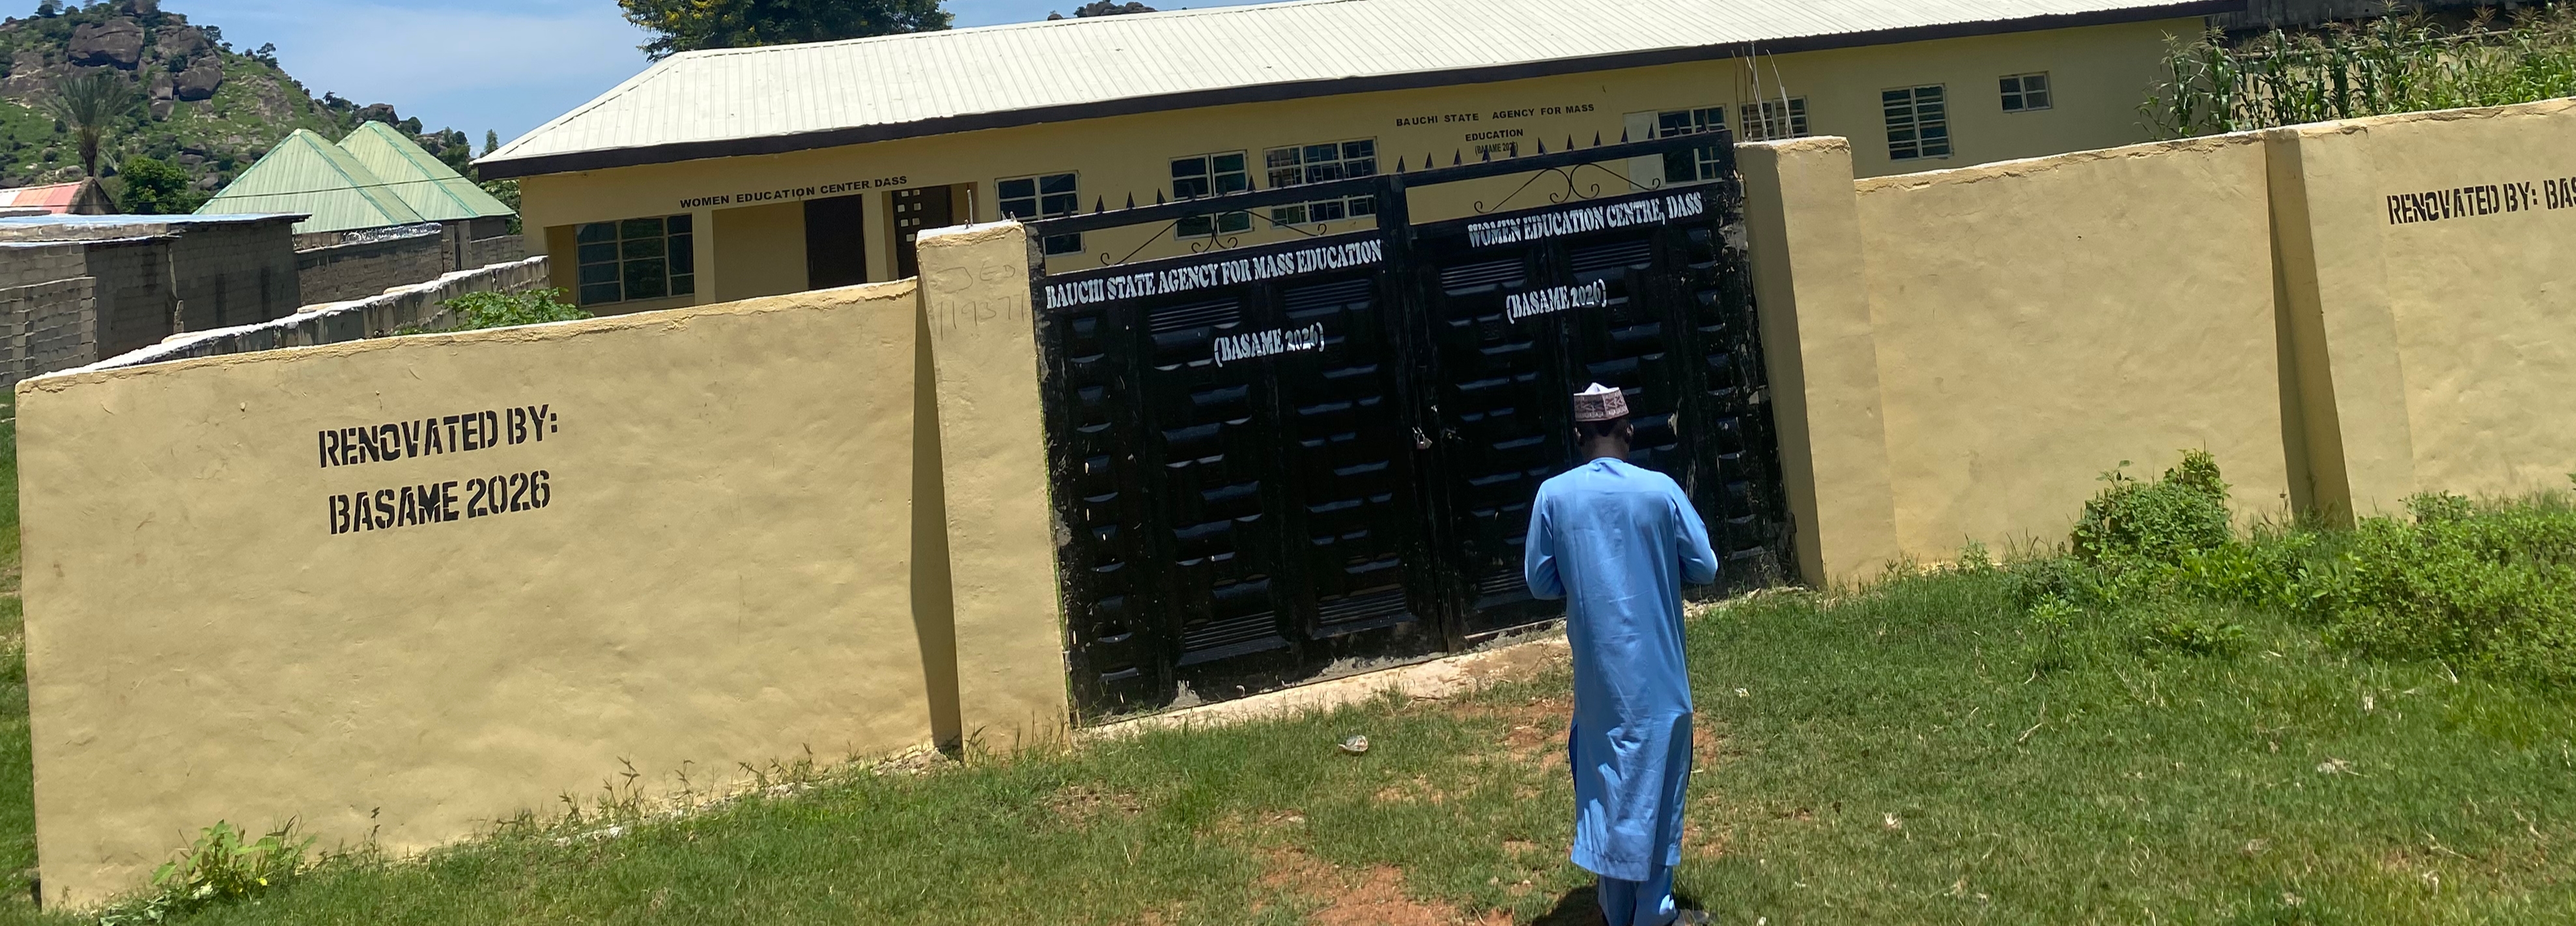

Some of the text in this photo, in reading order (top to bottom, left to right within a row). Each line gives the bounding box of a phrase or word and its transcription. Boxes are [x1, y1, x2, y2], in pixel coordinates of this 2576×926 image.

[1396, 104, 1594, 126] BAUCHI STATE AGENCY FOR MASS
[1465, 128, 1523, 141] EDUCATION
[680, 195, 729, 208] WOMEN
[736, 186, 815, 203] EDUCATION
[874, 175, 907, 188] DASS
[2386, 184, 2500, 225] RENOVATED
[2503, 181, 2538, 212] BY:
[1467, 192, 1703, 248] WOMEN EDUCATION CENTRE, DASS
[1045, 239, 1383, 310] BAUCHI STATE AGENCY FOR MASS EDUCATION
[1506, 278, 1607, 325] (BASAME 2026)
[1213, 322, 1325, 368] (BASAME 2026)
[318, 404, 558, 468] RENOVATED BY:
[329, 470, 550, 534] BASAME 2026
